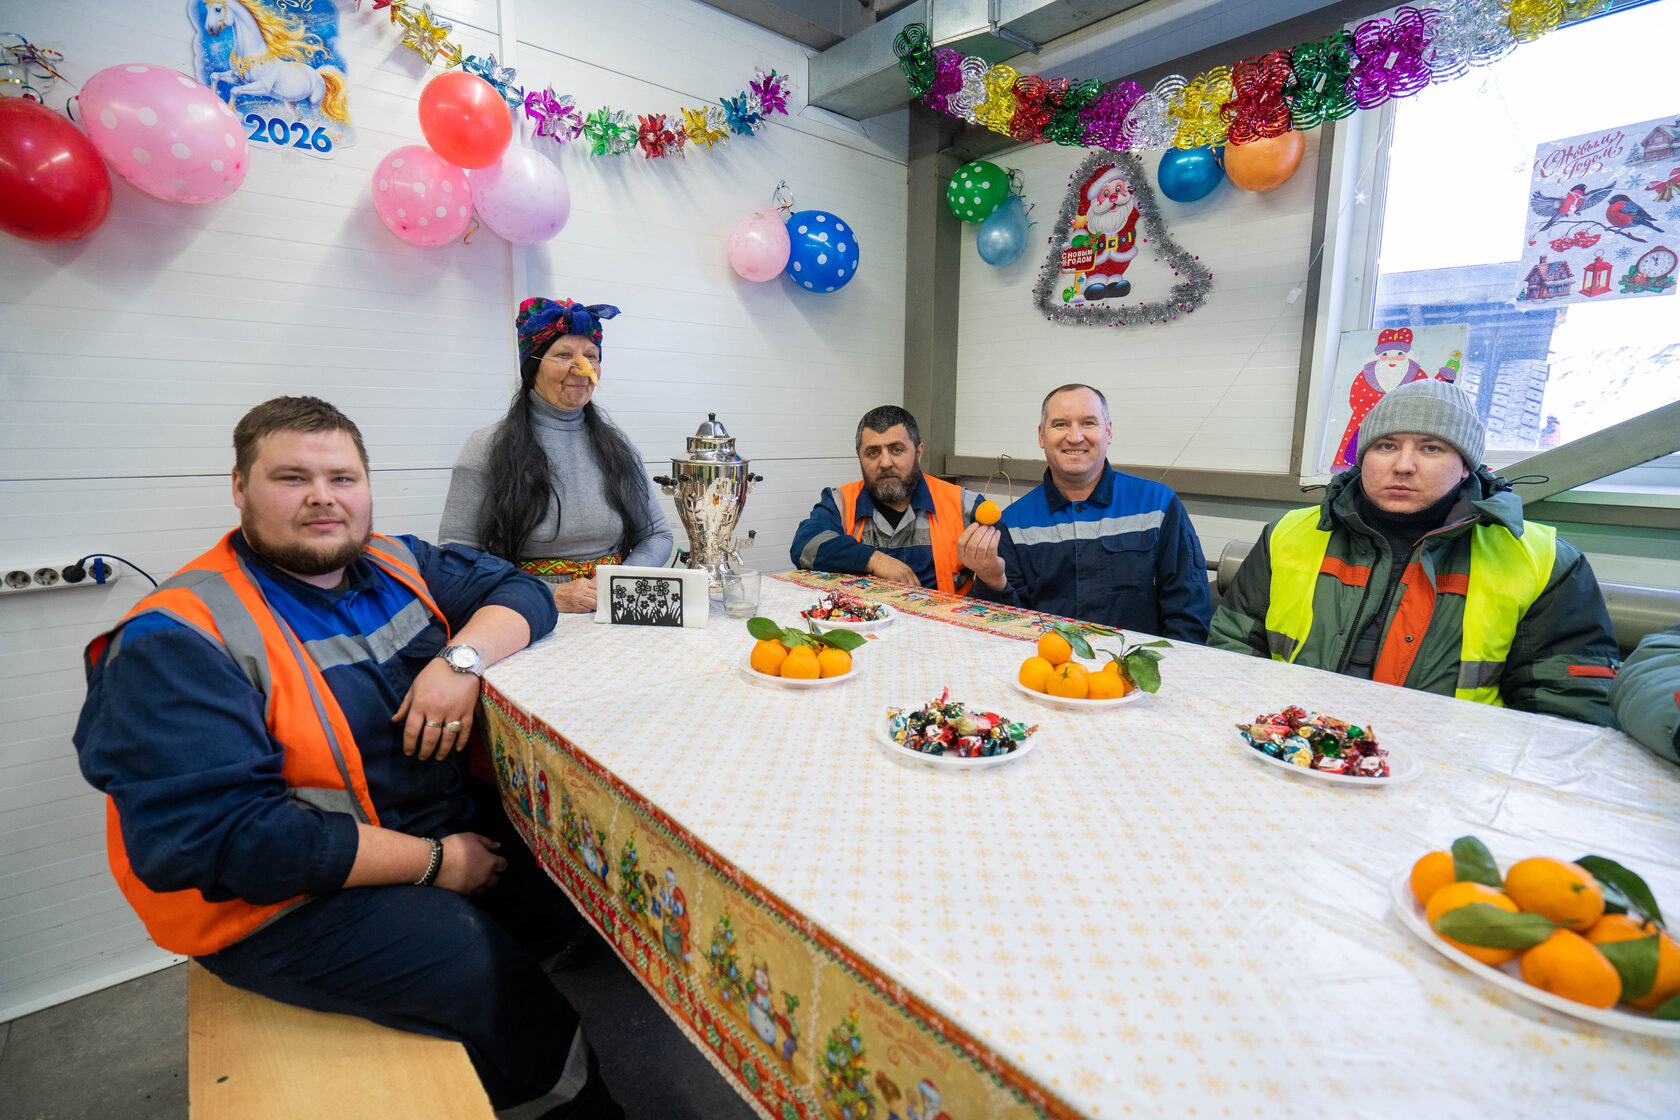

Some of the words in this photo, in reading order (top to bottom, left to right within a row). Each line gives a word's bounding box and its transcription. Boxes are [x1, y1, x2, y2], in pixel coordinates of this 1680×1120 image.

[245, 114, 333, 153] 2026
[1061, 252, 1067, 260] С
[1067, 255, 1092, 267] ГОДОМ
